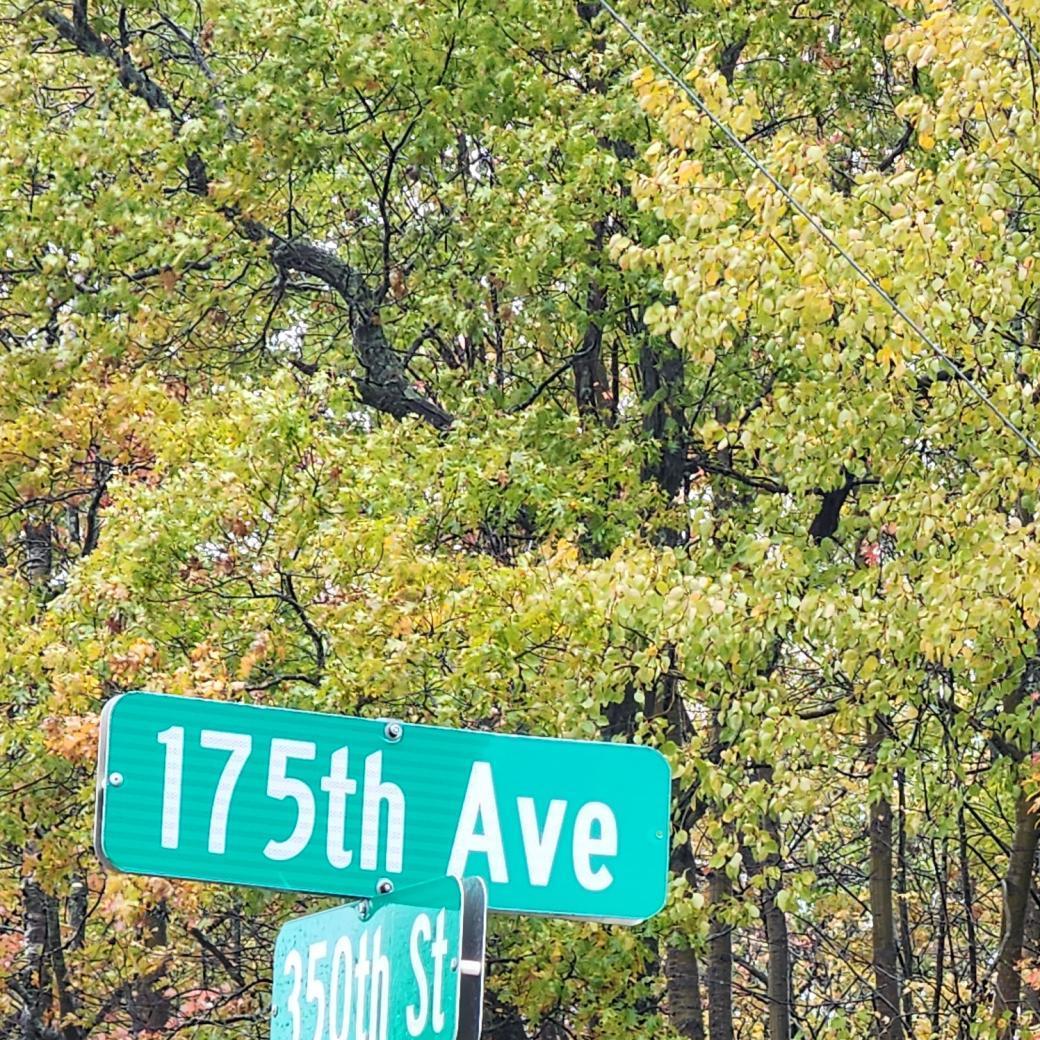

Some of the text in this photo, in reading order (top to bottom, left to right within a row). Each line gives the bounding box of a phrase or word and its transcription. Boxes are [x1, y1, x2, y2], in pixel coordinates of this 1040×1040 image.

[157, 725, 618, 891] 175th Ave
[406, 907, 448, 1036] St
